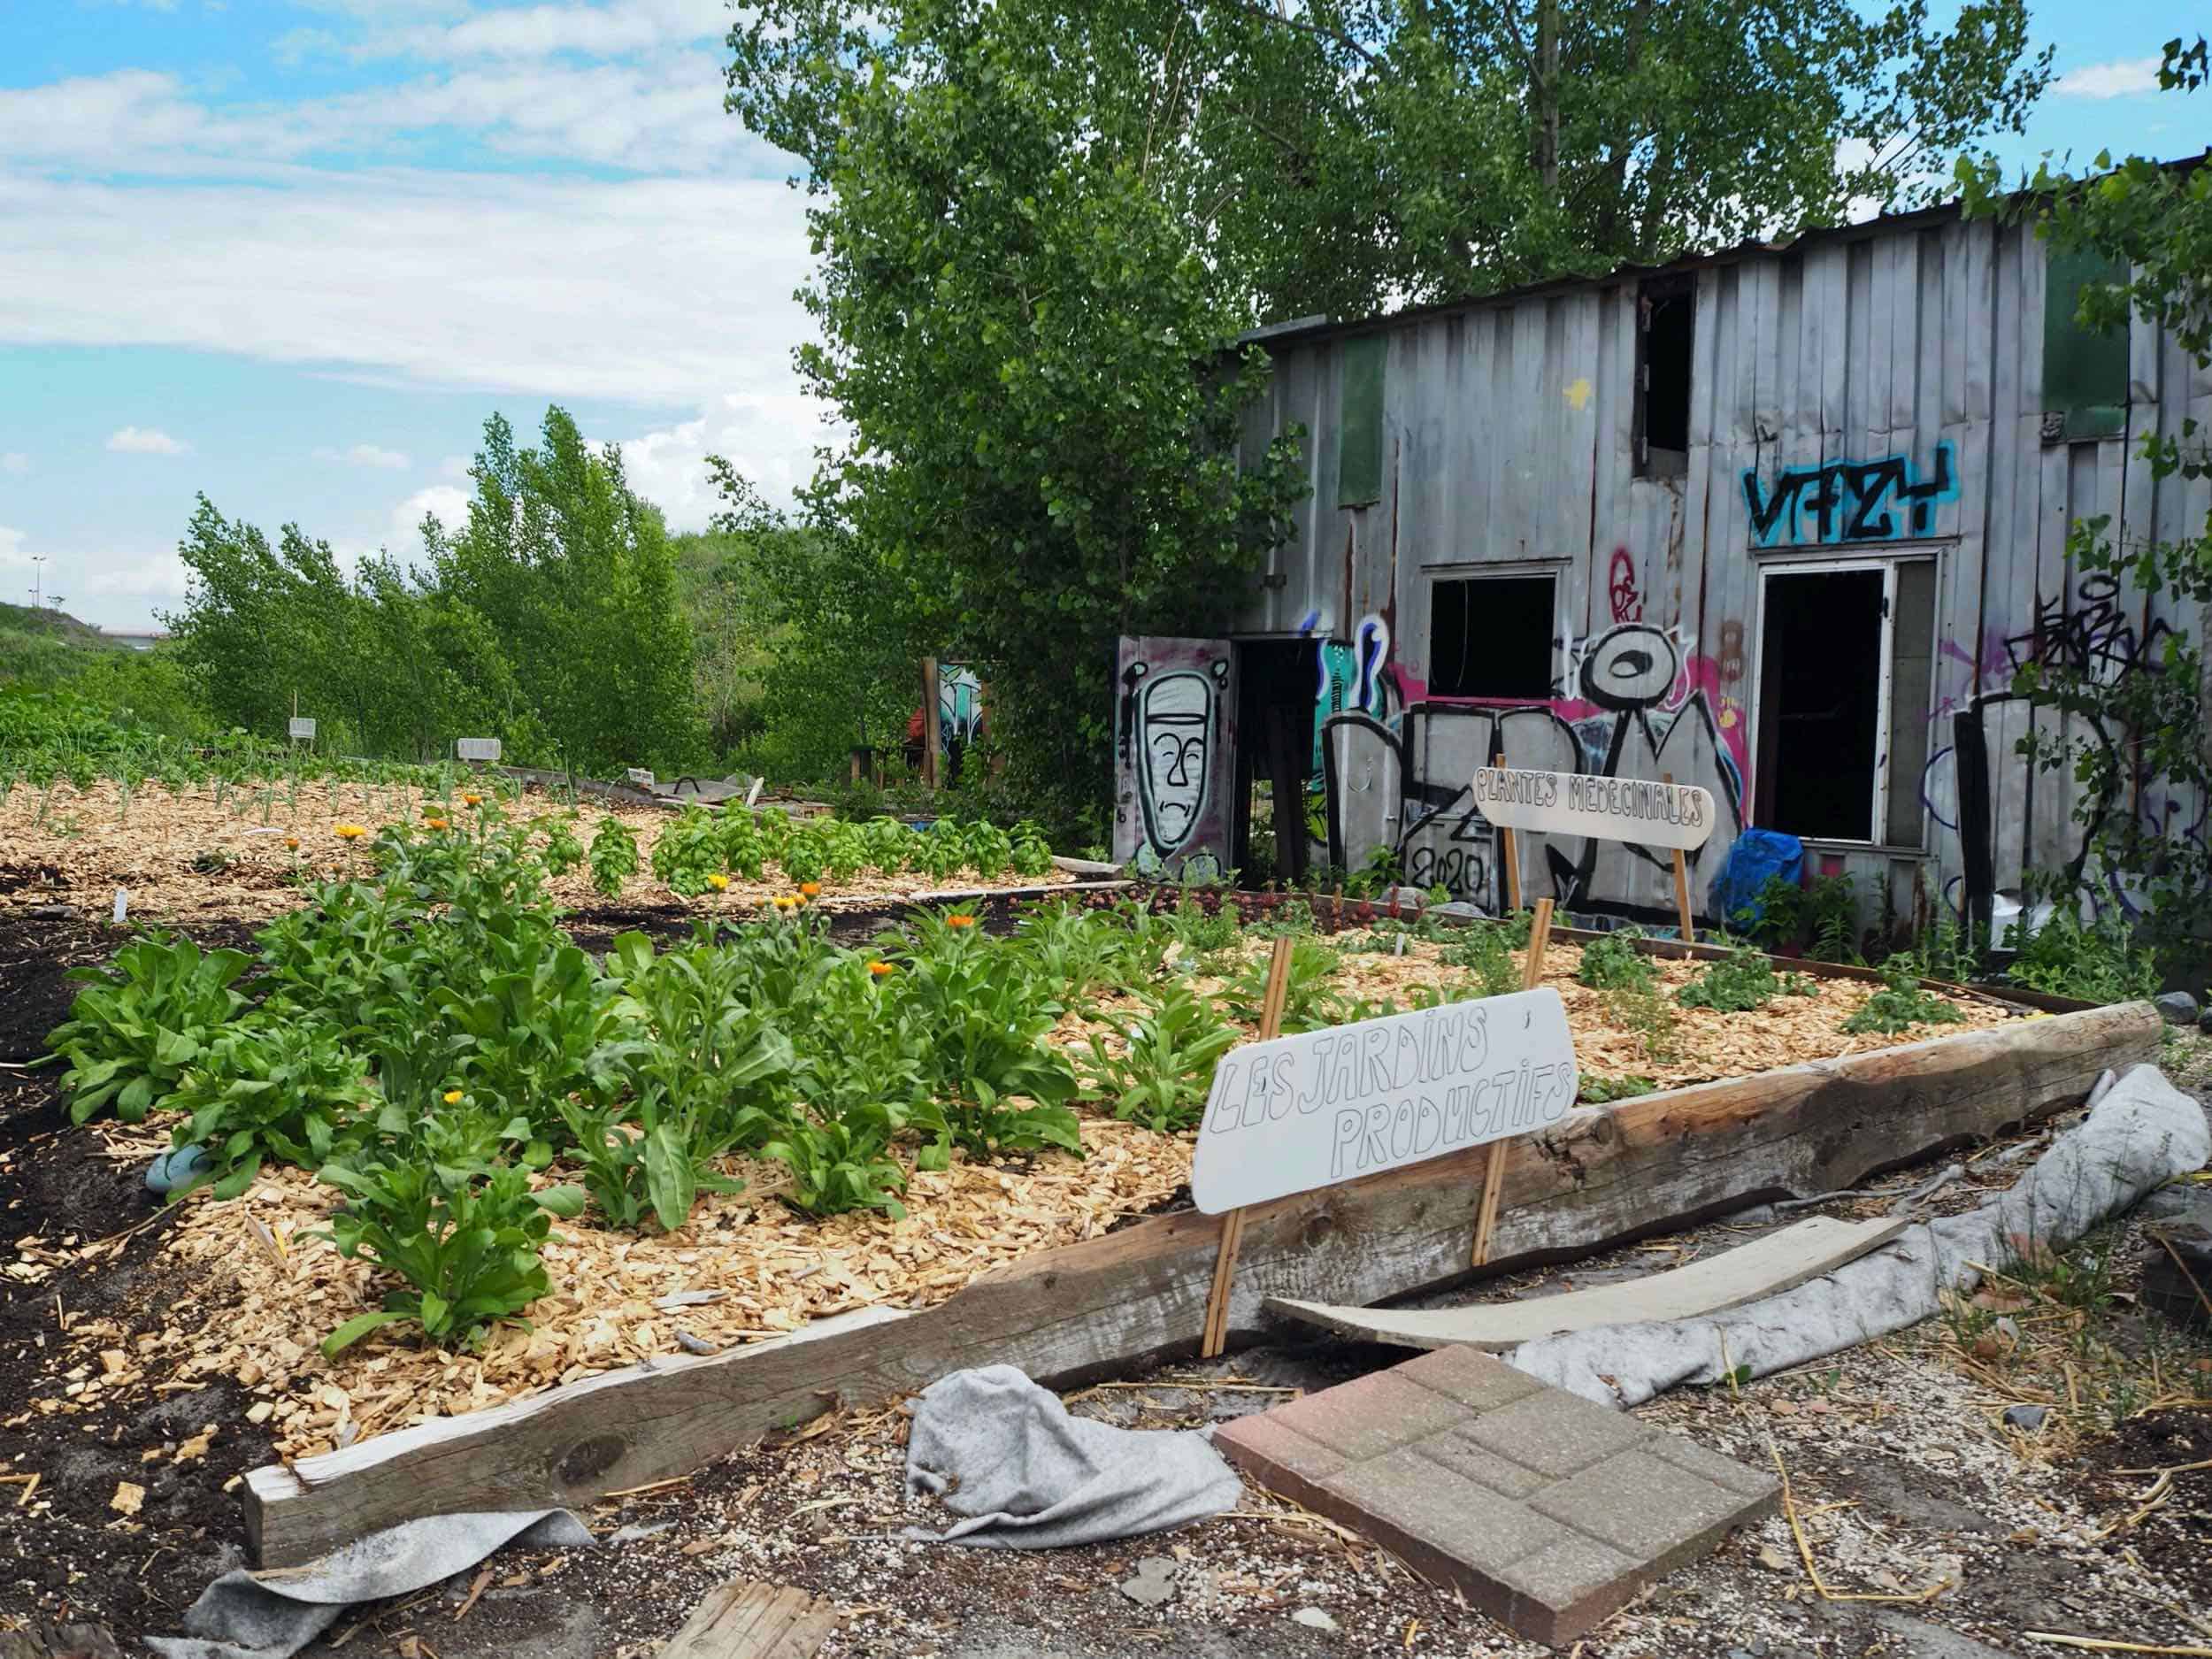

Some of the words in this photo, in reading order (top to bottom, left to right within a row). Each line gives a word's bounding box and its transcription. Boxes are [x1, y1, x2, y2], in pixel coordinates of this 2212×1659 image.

[1476, 768, 1558, 808] PLANTES
[1412, 846, 1484, 895] 2020
[1210, 1052, 1294, 1134] LES
